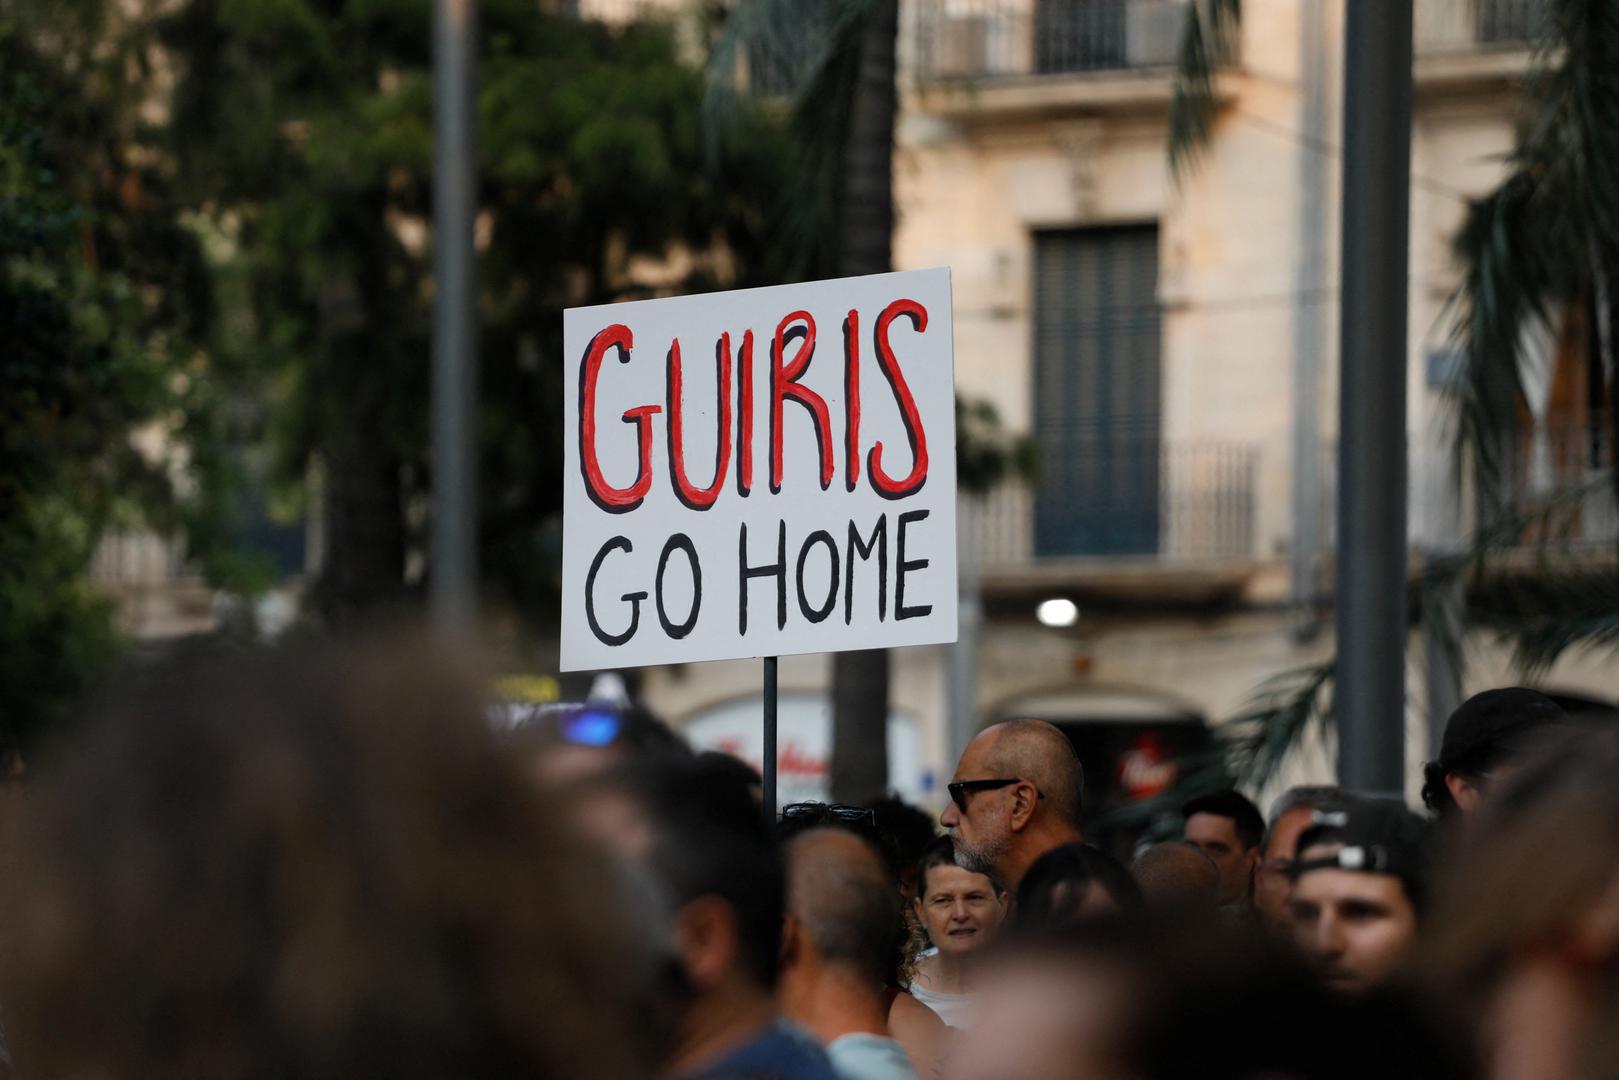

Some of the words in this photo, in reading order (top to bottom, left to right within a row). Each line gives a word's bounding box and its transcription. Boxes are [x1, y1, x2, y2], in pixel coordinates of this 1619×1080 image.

[578, 299, 929, 514] GUIRIS
[585, 533, 701, 646] GO
[739, 509, 933, 636] HOME
